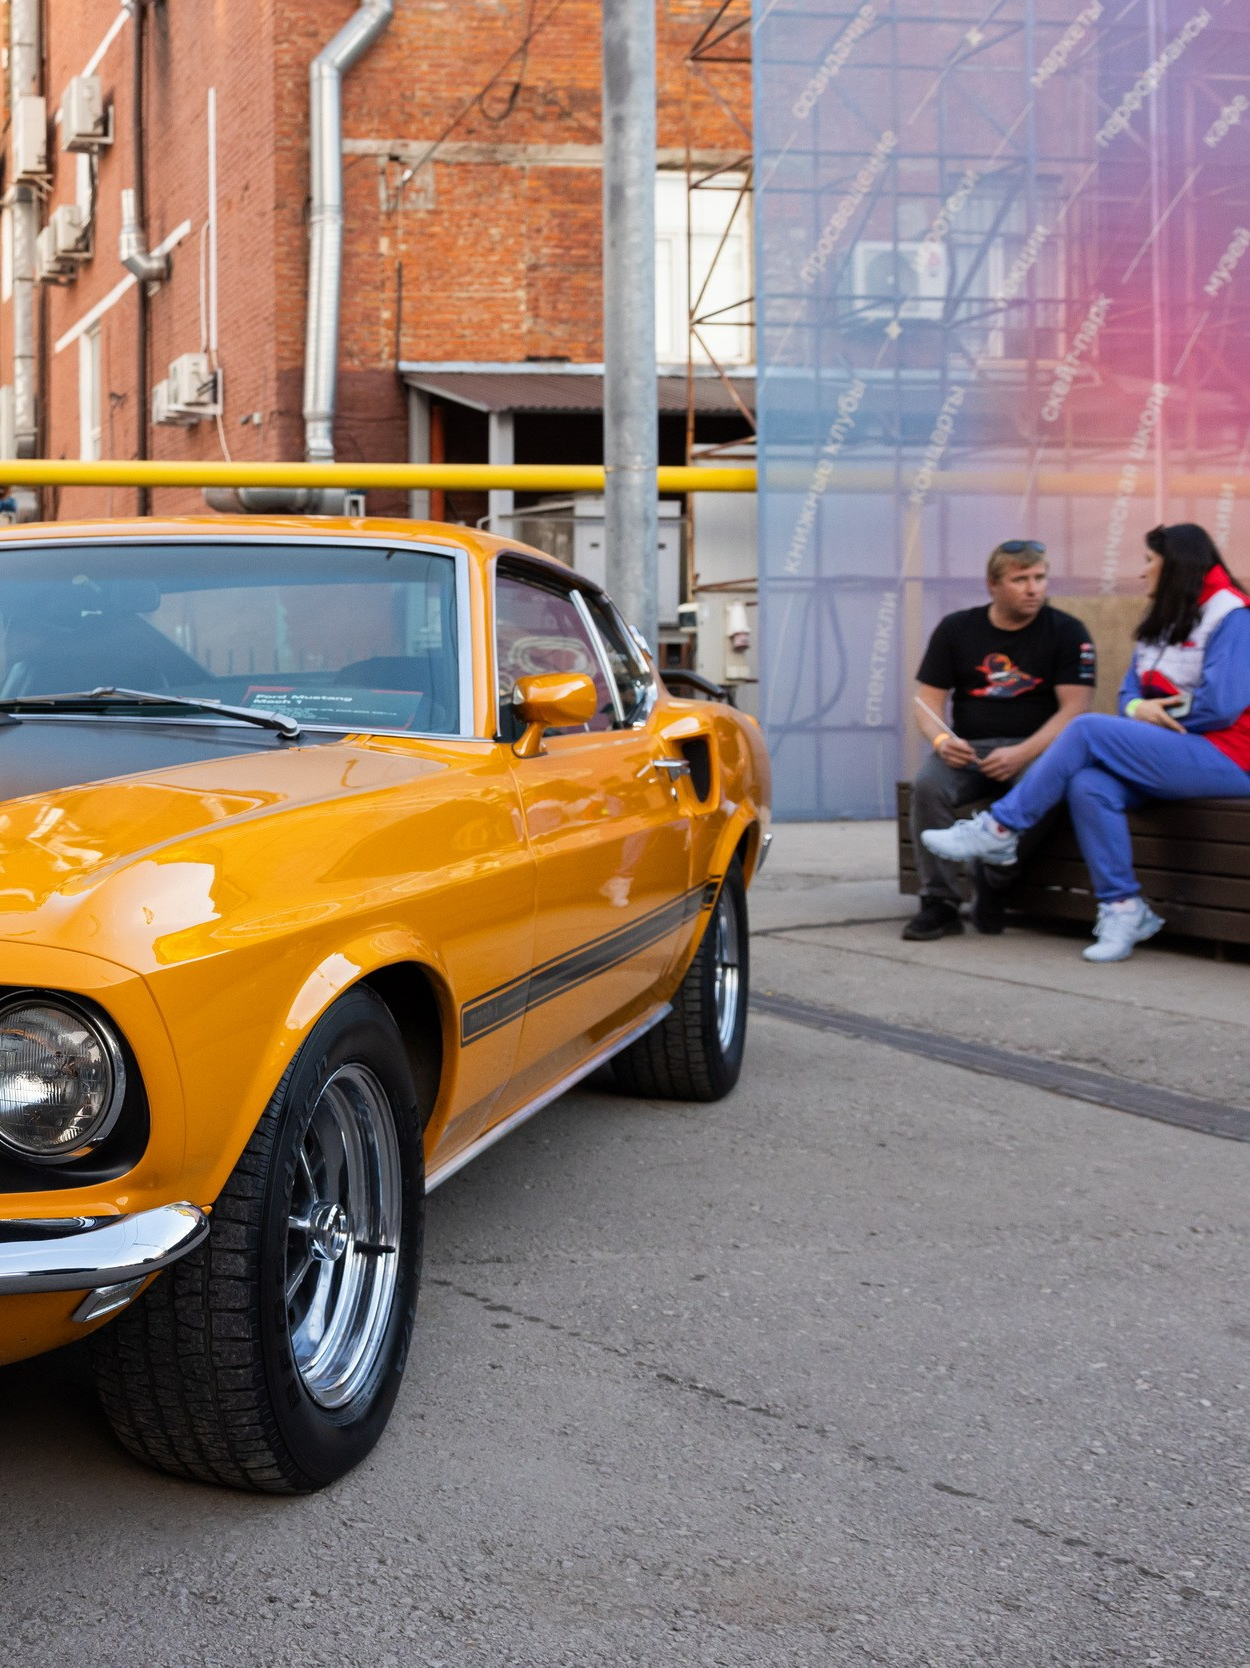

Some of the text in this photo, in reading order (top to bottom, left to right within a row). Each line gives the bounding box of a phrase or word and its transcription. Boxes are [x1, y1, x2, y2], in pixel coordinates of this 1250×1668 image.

[1096, 8, 1212, 147] перформансы
[1203, 95, 1250, 148] кафе
[801, 130, 898, 284] просвещение
[1041, 292, 1112, 422] скейт-парк
[909, 384, 965, 505] концерты
[784, 460, 833, 574] книжные
[291, 694, 353, 702] Mustang
[865, 591, 898, 727] спектакли
